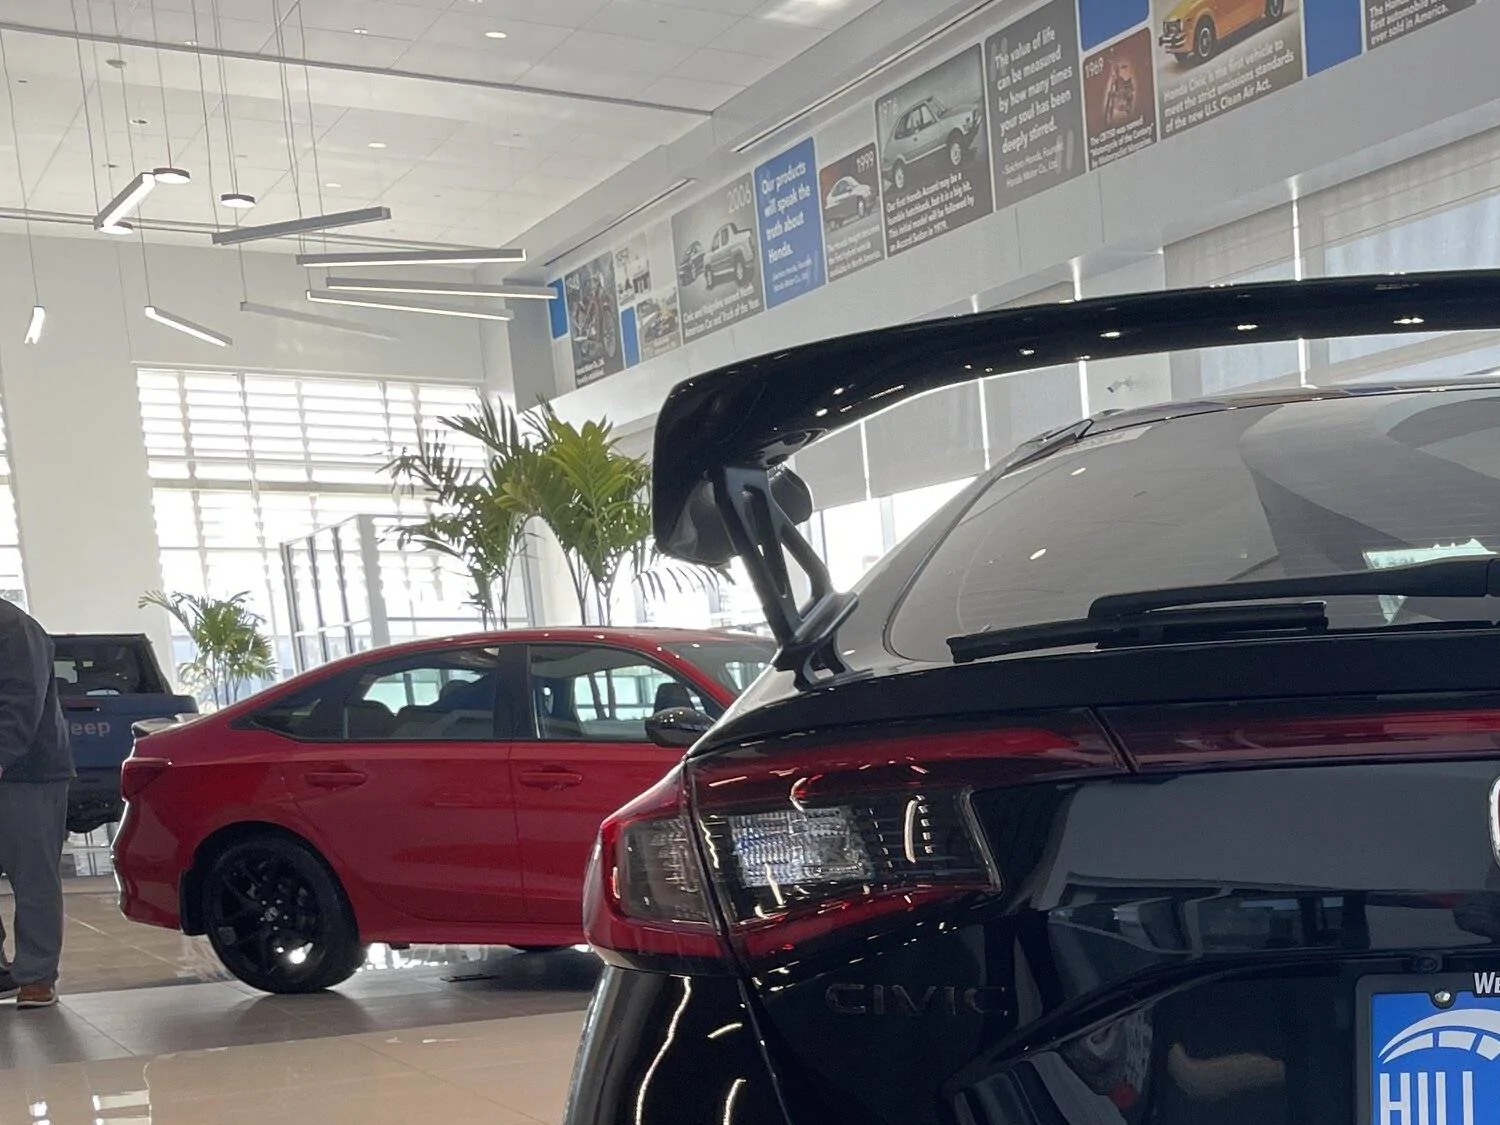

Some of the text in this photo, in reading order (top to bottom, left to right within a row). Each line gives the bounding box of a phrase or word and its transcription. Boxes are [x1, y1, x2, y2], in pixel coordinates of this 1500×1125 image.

[994, 26, 1055, 67] The value of life
[997, 44, 1062, 89] can be measured
[997, 66, 1073, 113] by how many times
[1164, 78, 1272, 132] of the new U.S. Clean Air Act.
[999, 90, 1071, 136] your soul has been
[1001, 131, 1028, 152] deeply
[761, 162, 806, 194] Our products
[856, 151, 874, 174] 1999
[776, 188, 797, 213] speak
[798, 183, 810, 199] the
[783, 211, 803, 230] about
[70, 721, 111, 737] eep
[825, 984, 1008, 1016] CIVIC
